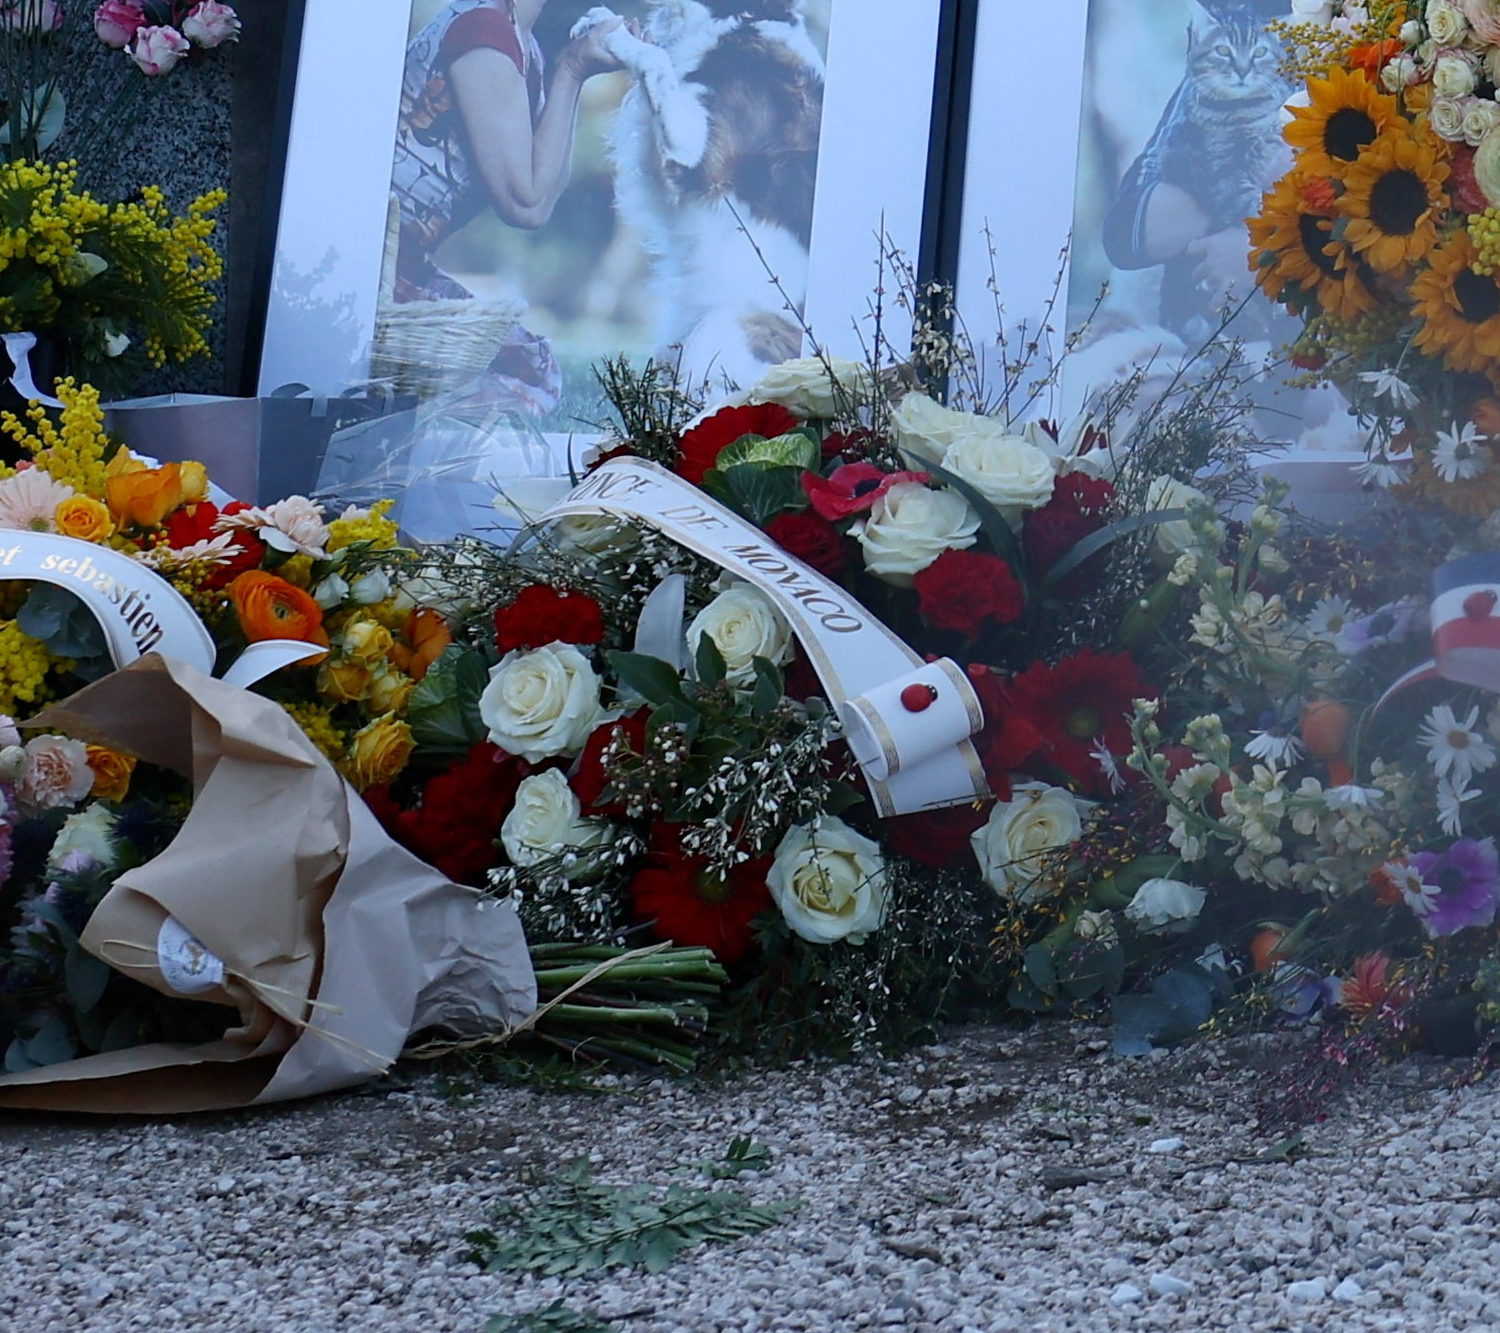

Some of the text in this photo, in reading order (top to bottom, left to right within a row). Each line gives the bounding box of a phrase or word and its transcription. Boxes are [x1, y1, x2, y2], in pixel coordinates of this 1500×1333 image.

[39, 549, 165, 654] sebastien
[658, 505, 731, 533] DE
[723, 544, 863, 633] MONACO
